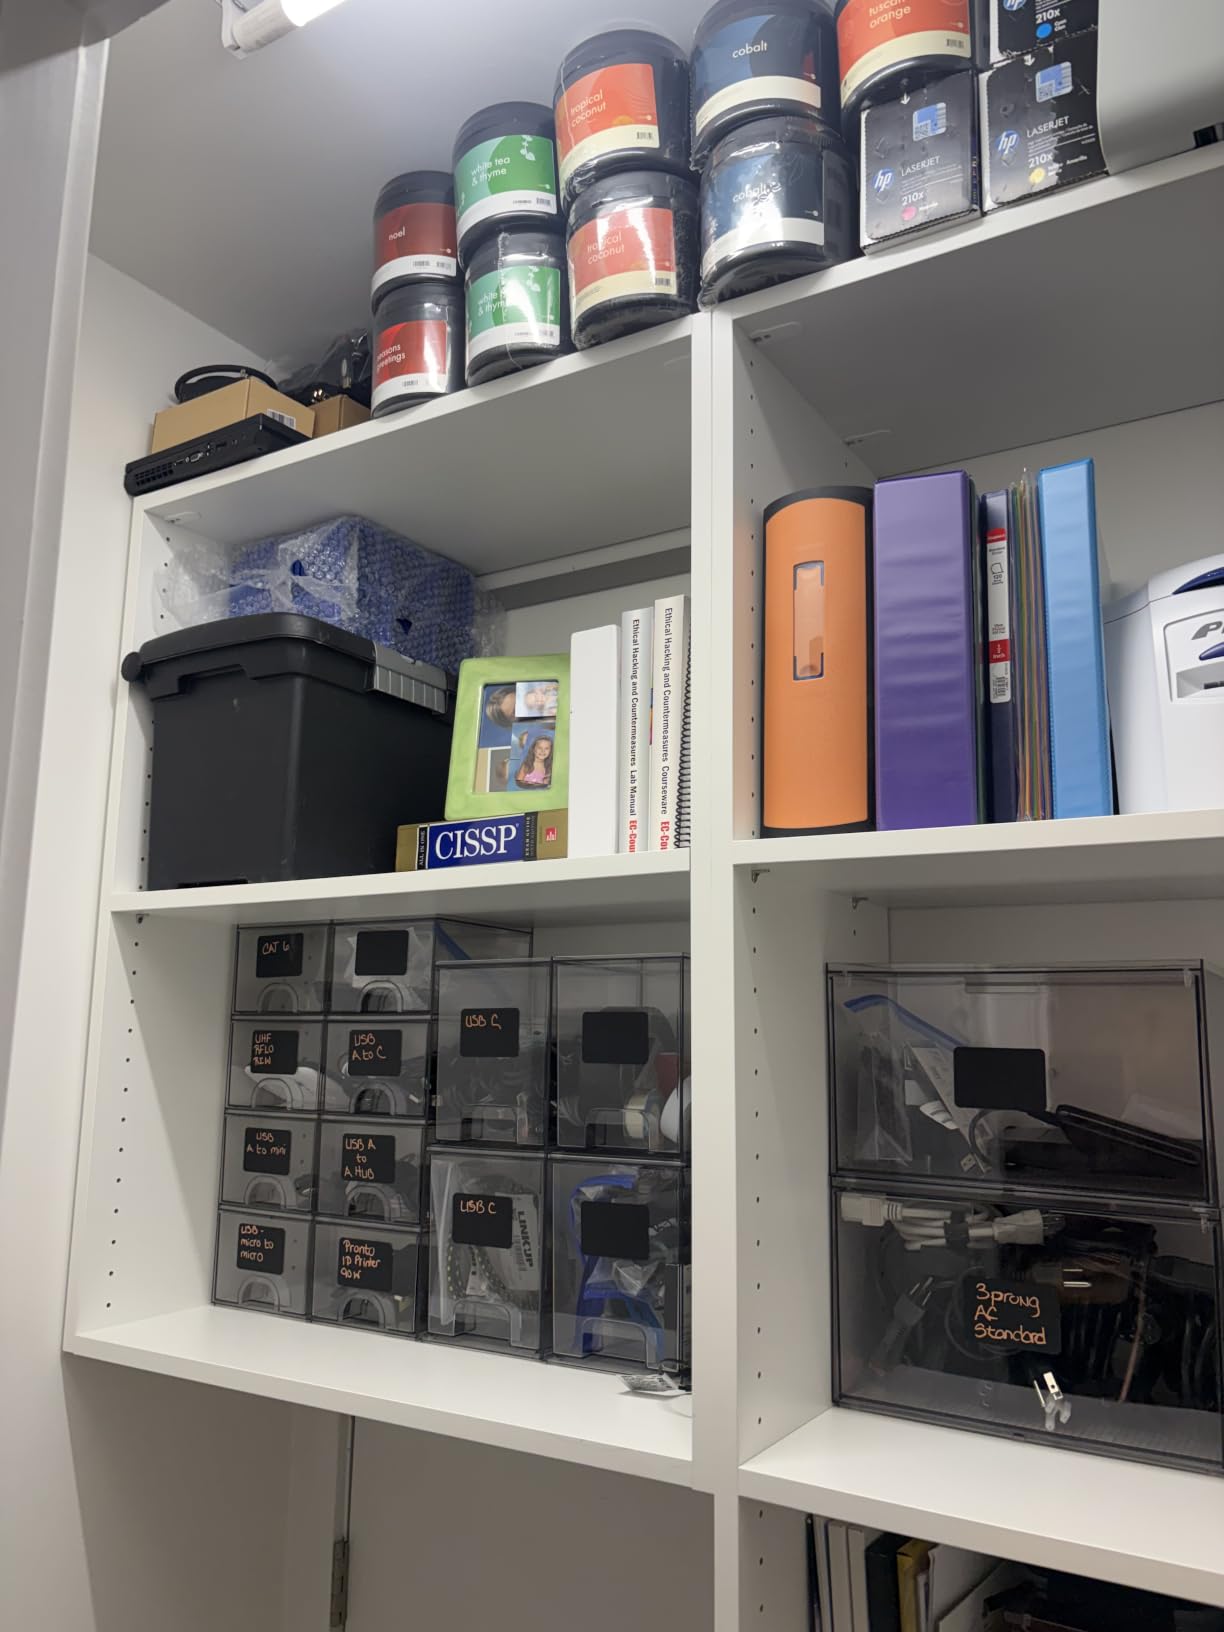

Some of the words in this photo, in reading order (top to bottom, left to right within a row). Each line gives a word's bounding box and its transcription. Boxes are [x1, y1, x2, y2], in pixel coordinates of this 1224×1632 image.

[869, 0, 905, 16] tusca
[869, 6, 911, 29] orange
[732, 40, 768, 59] cobalt
[570, 89, 603, 114] tropical
[571, 101, 607, 127] coconut
[1026, 115, 1070, 138] LASERJET
[997, 131, 1018, 155] hp
[495, 156, 511, 167] tea
[901, 155, 941, 177] LASERJET
[480, 167, 507, 183] thyme
[873, 168, 893, 193] hp
[388, 225, 406, 241] noel
[587, 243, 625, 265] coconut
[664, 607, 673, 637] Ethical
[631, 618, 640, 646] Ethical
[662, 637, 672, 671] Hacking
[630, 647, 639, 680] Hacking
[663, 672, 671, 688] and
[630, 697, 639, 767] Countermeasures
[662, 688, 671, 763] Countermeasures
[660, 765, 670, 815] Courseware
[629, 785, 637, 816] Manual
[435, 824, 517, 860] CISSP
[262, 940, 280, 955] CAT
[282, 940, 290, 952] 6
[465, 1014, 487, 1028] USB
[255, 1032, 272, 1044] UHF
[354, 1032, 376, 1047] USB
[352, 1049, 362, 1061] A
[362, 1049, 374, 1061] to
[376, 1045, 387, 1059] C
[255, 1131, 274, 1142] USB
[345, 1138, 364, 1151] USB
[367, 1138, 376, 1150] A
[246, 1143, 255, 1153] A
[256, 1143, 267, 1155] to
[355, 1152, 367, 1164] to
[344, 1166, 352, 1177] A
[354, 1165, 375, 1180] HUB
[460, 1199, 485, 1214] USB
[487, 1202, 497, 1214] C
[240, 1237, 261, 1248] micro
[263, 1238, 274, 1250] to
[342, 1239, 376, 1257] Pronto
[517, 1210, 534, 1268] LINKUP
[240, 1250, 264, 1263] micro
[354, 1254, 381, 1268] Printer
[974, 1304, 999, 1321] AC
[974, 1323, 1047, 1345] Standard
